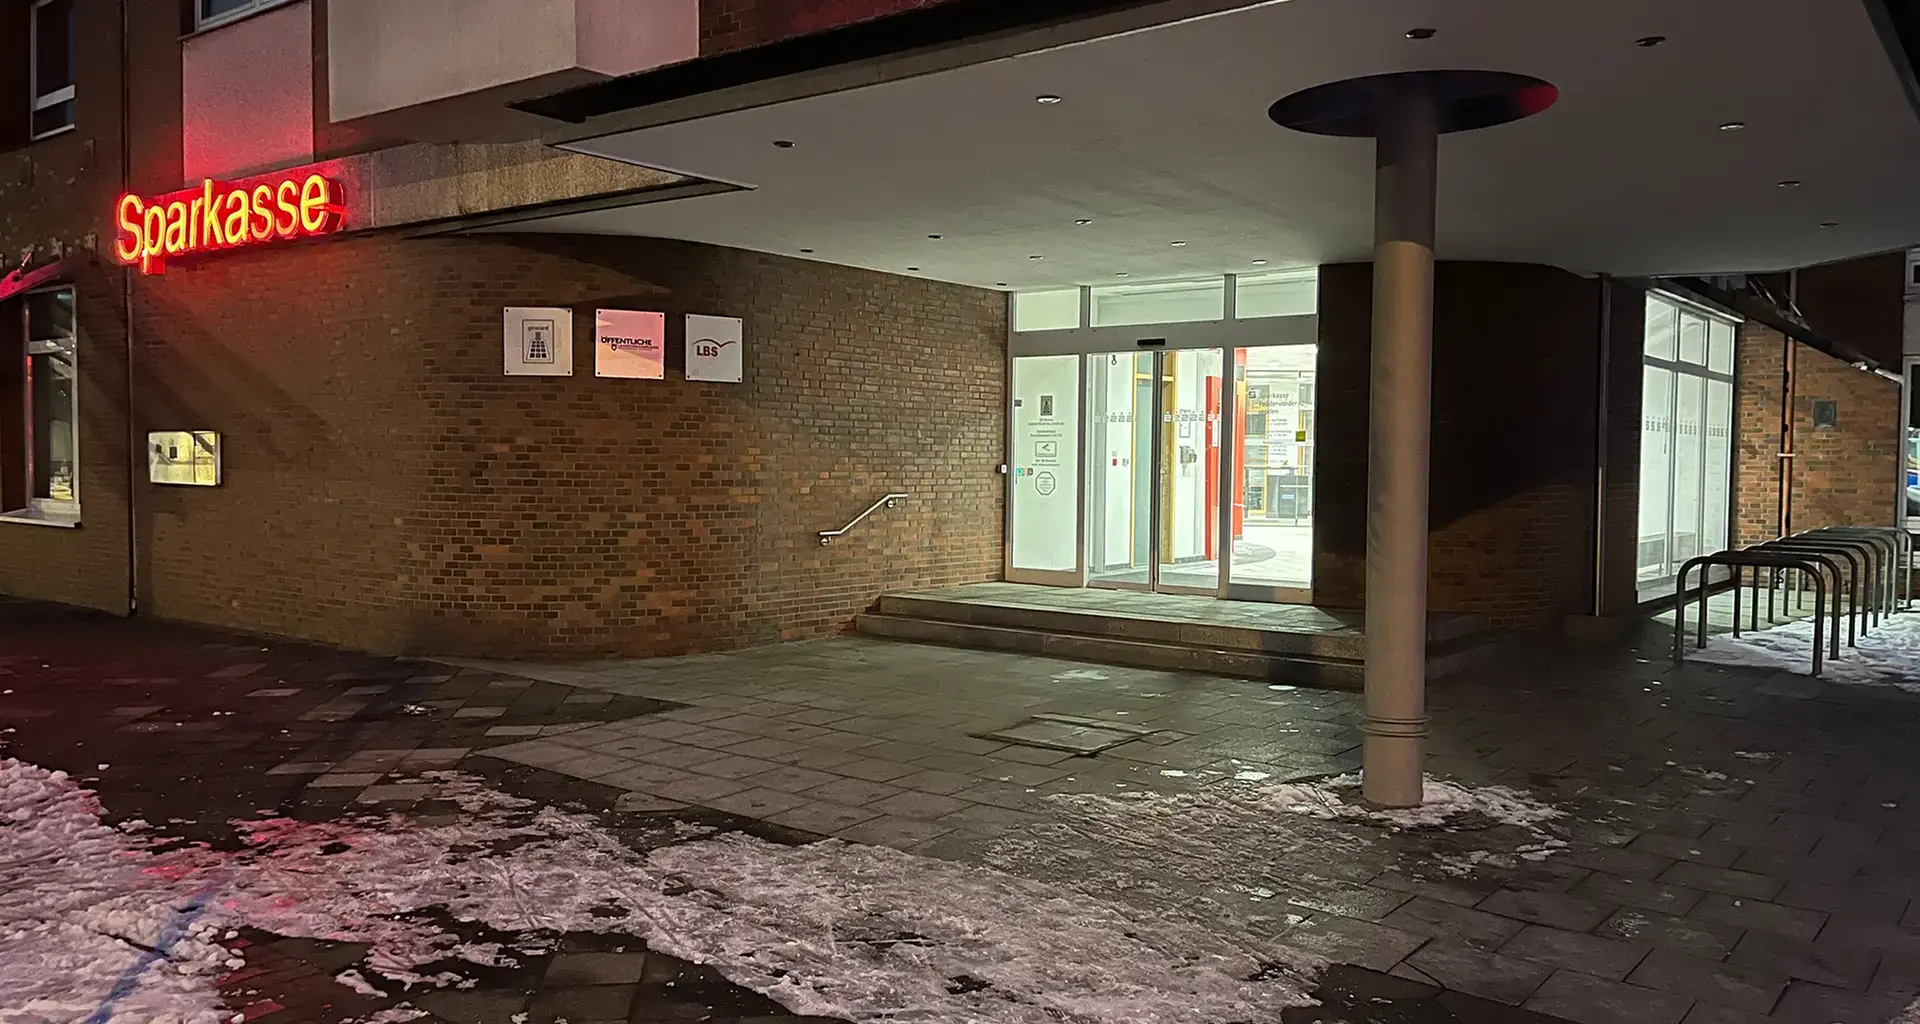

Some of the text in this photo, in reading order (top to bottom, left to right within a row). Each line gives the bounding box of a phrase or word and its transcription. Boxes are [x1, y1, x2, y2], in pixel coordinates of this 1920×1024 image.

[118, 173, 331, 275] Sparkasse
[600, 335, 652, 346] ÖFFENTLICHE
[696, 345, 718, 357] LBS
